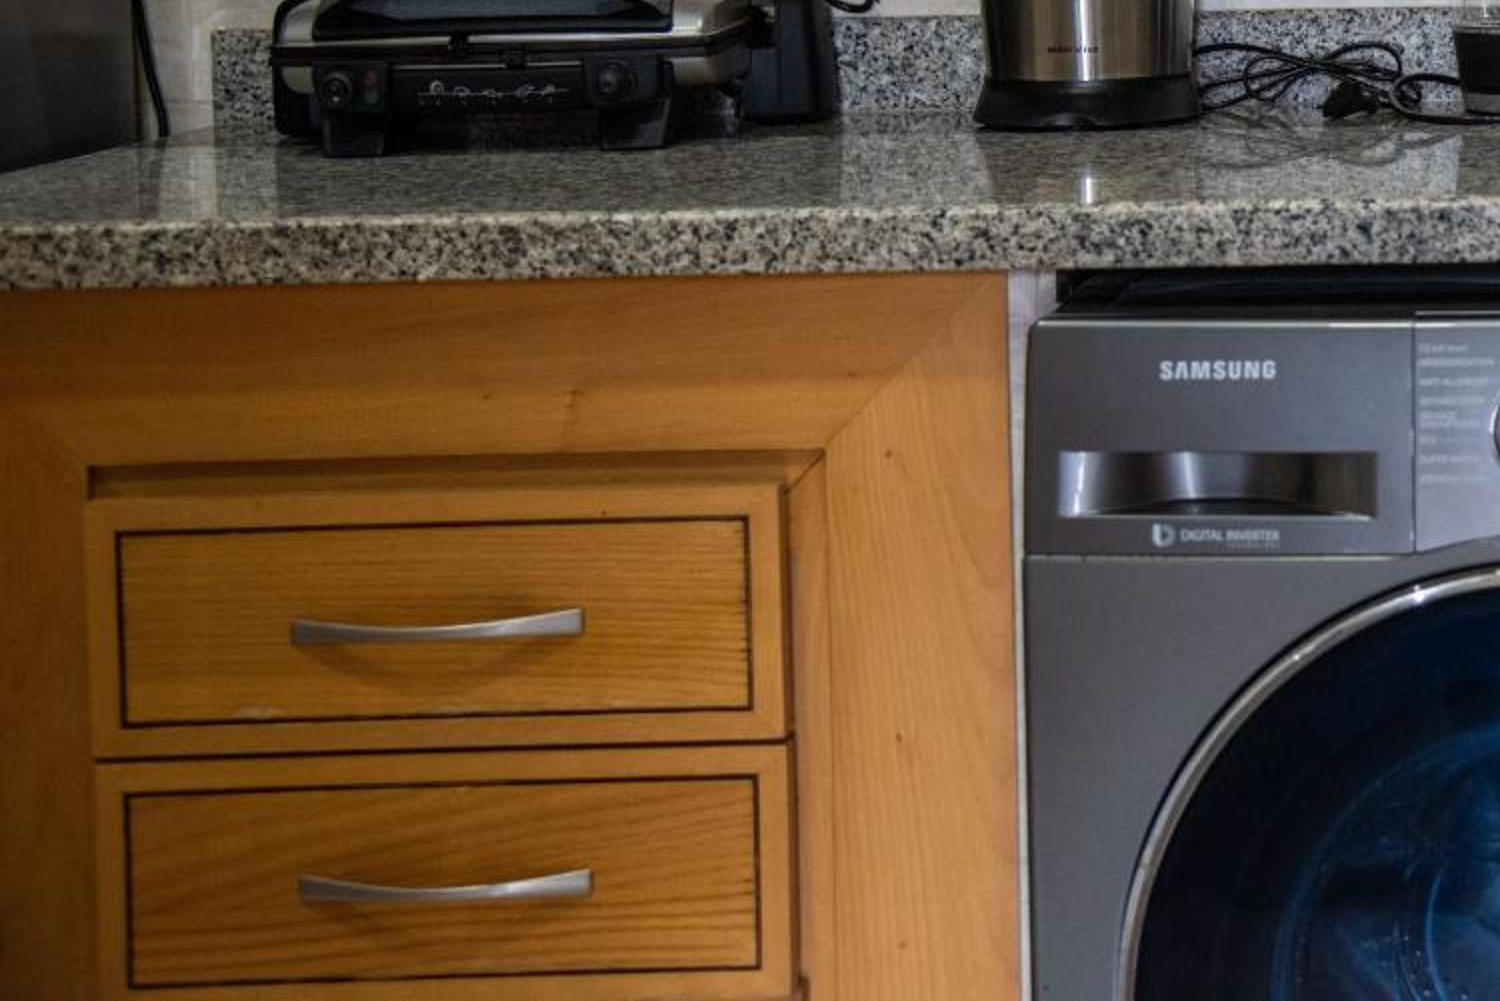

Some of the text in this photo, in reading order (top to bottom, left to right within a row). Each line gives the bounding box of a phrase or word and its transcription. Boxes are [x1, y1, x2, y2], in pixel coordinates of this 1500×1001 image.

[1159, 360, 1277, 380] SAMSUNG
[1181, 529, 1223, 541] DIGITAL
[1226, 529, 1280, 541] INVERTER
